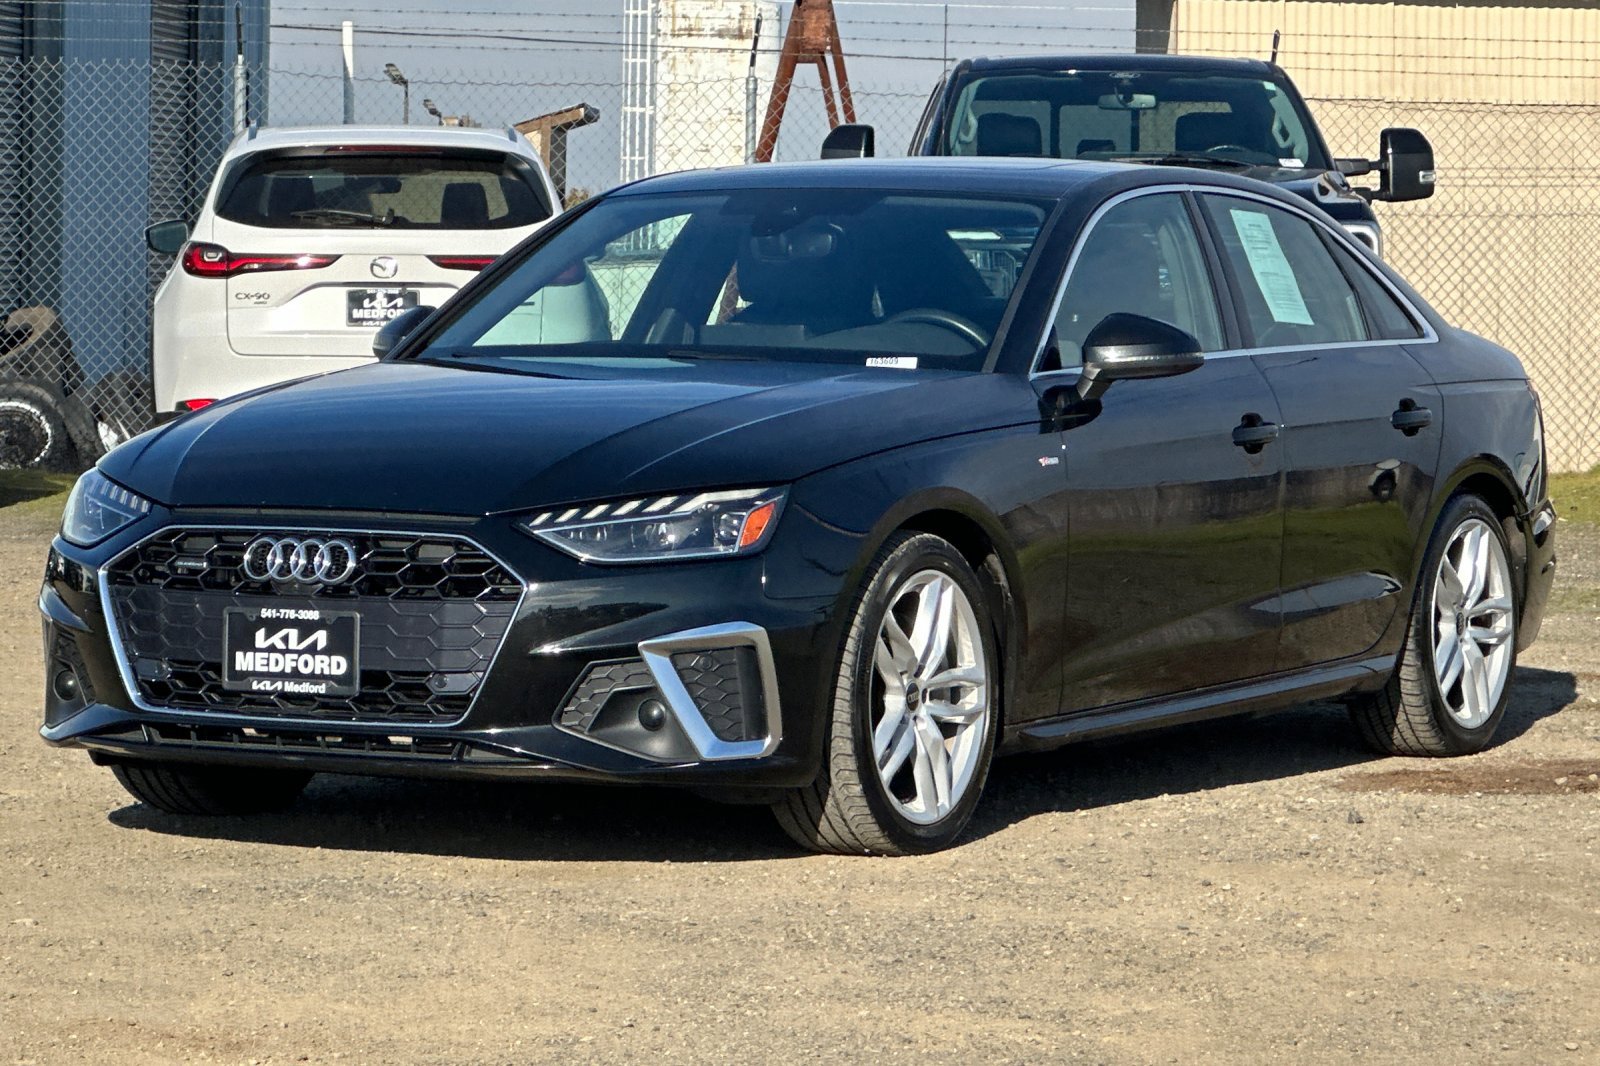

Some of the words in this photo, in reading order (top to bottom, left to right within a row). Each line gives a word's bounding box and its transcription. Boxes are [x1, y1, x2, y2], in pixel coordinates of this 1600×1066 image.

[235, 292, 270, 300] CX-90
[255, 627, 327, 651] KIA
[235, 651, 348, 675] MEDFORD
[252, 680, 282, 691] KIA
[284, 681, 326, 694] Medford
